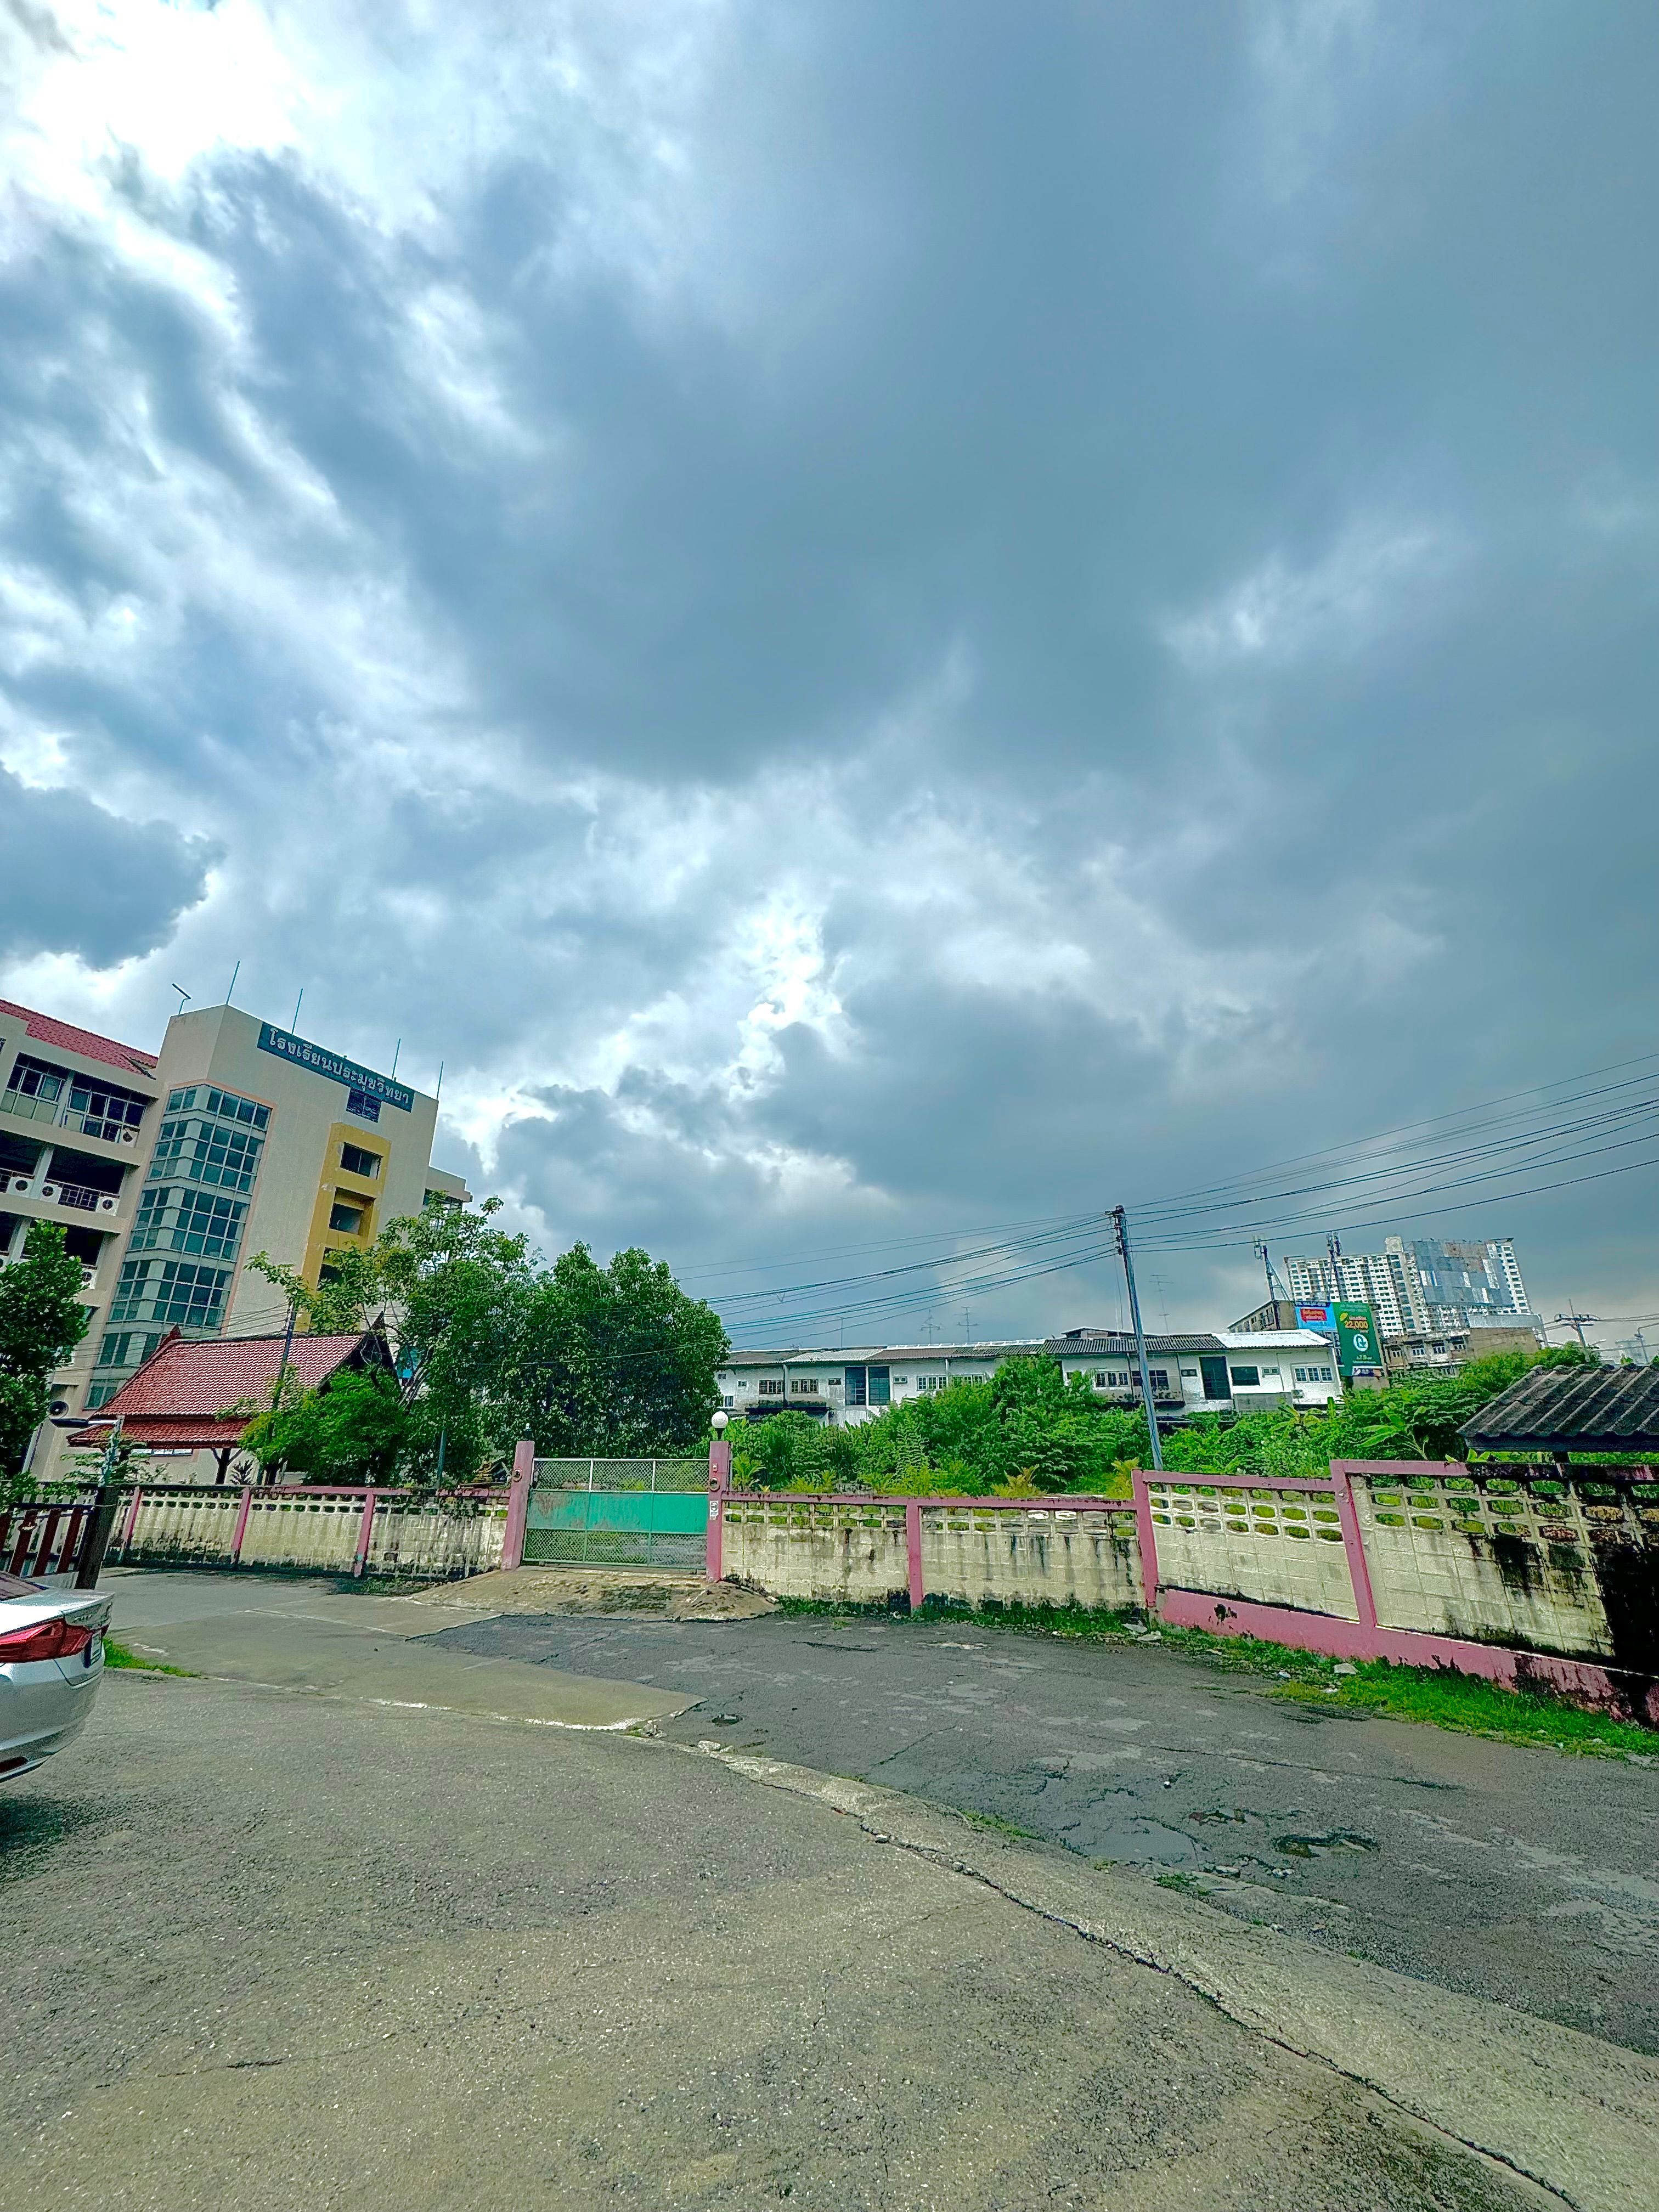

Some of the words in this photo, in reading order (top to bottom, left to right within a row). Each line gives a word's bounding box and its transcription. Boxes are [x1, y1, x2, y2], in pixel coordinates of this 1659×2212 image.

[269, 1028, 409, 1104] โรงเรียนประมุขวิทยา
